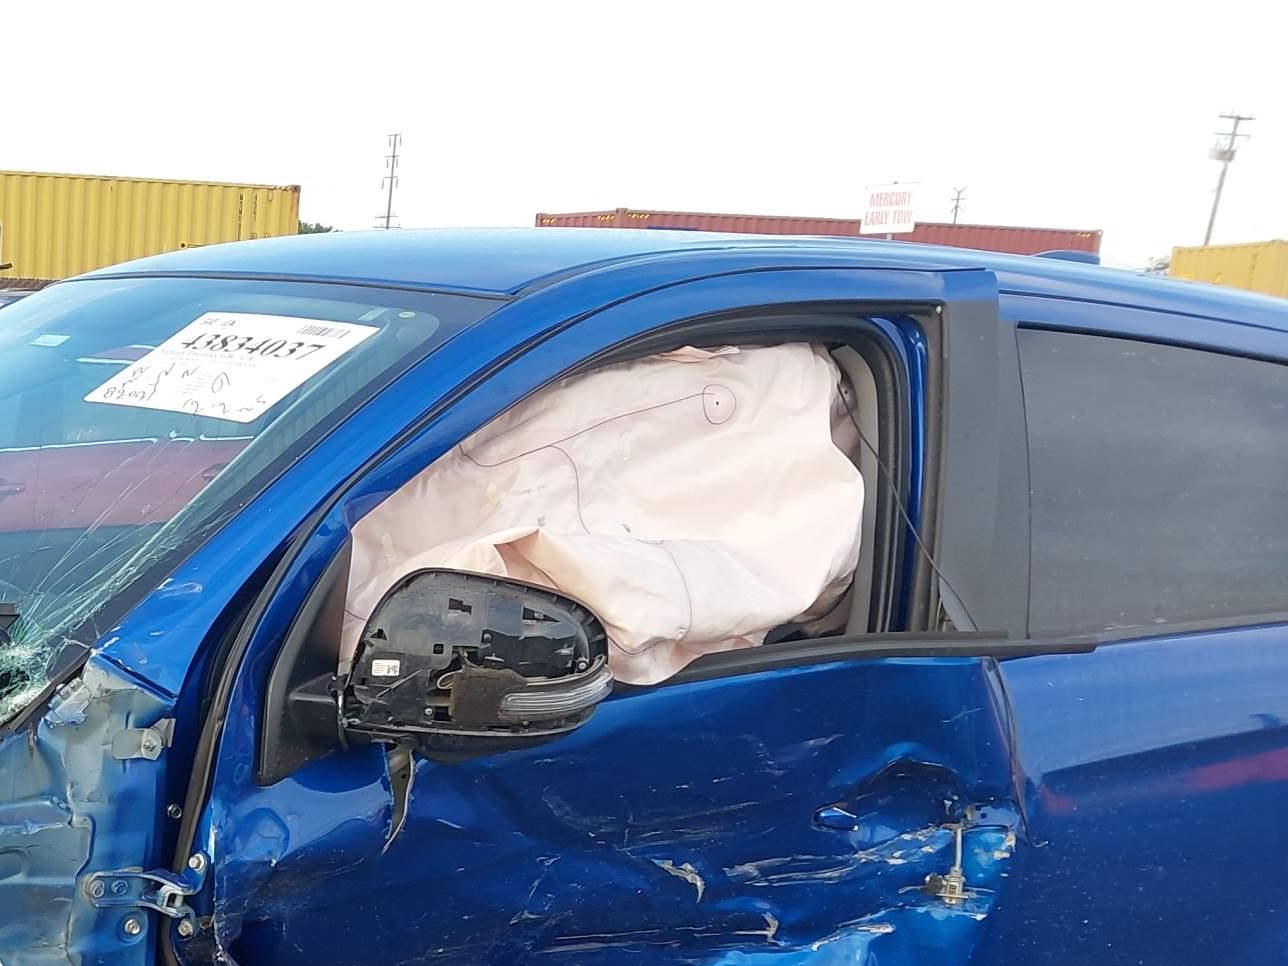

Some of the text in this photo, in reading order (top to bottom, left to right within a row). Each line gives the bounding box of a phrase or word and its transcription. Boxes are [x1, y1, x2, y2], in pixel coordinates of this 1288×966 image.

[869, 191, 912, 207] MERCURY
[864, 209, 913, 226] EARLY TOW
[181, 333, 327, 360] 43834037
